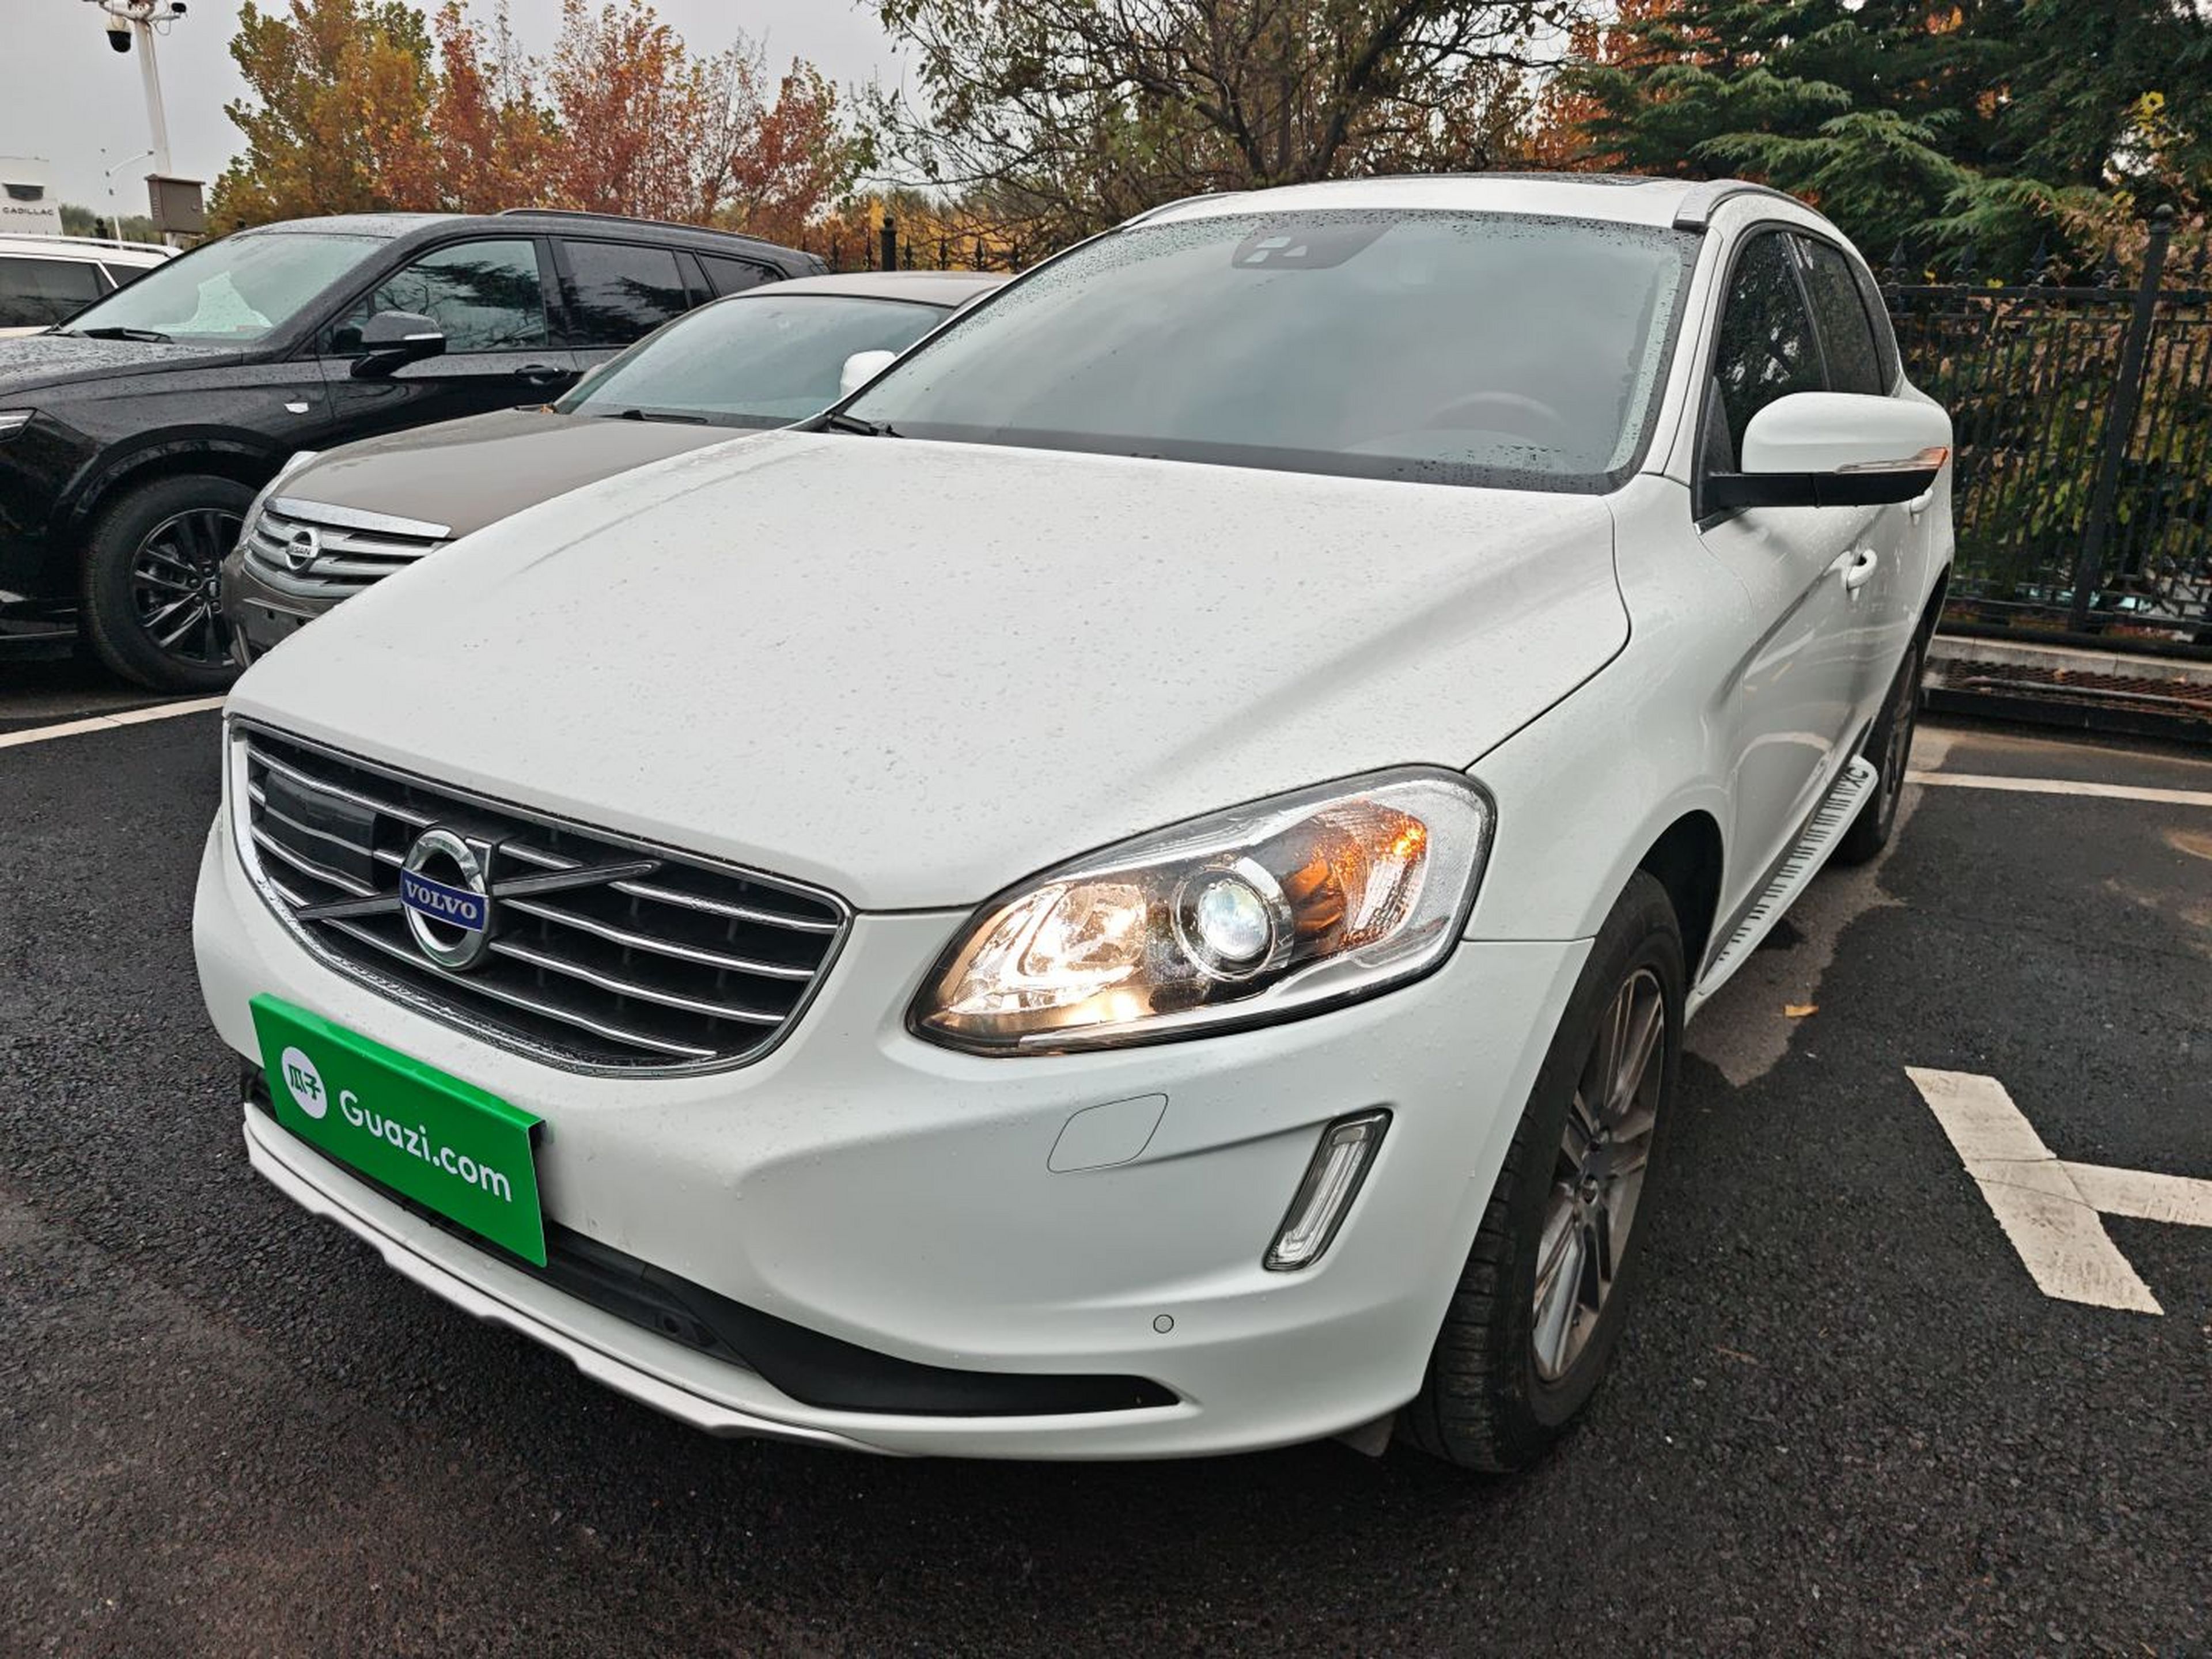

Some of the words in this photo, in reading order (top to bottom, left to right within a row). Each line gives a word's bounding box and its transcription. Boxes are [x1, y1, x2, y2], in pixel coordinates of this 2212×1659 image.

[2, 207, 54, 216] CADILLAC
[405, 879, 477, 920] VOLVO
[288, 1063, 321, 1100] 瓜子
[339, 1090, 512, 1202] Guazi.com
